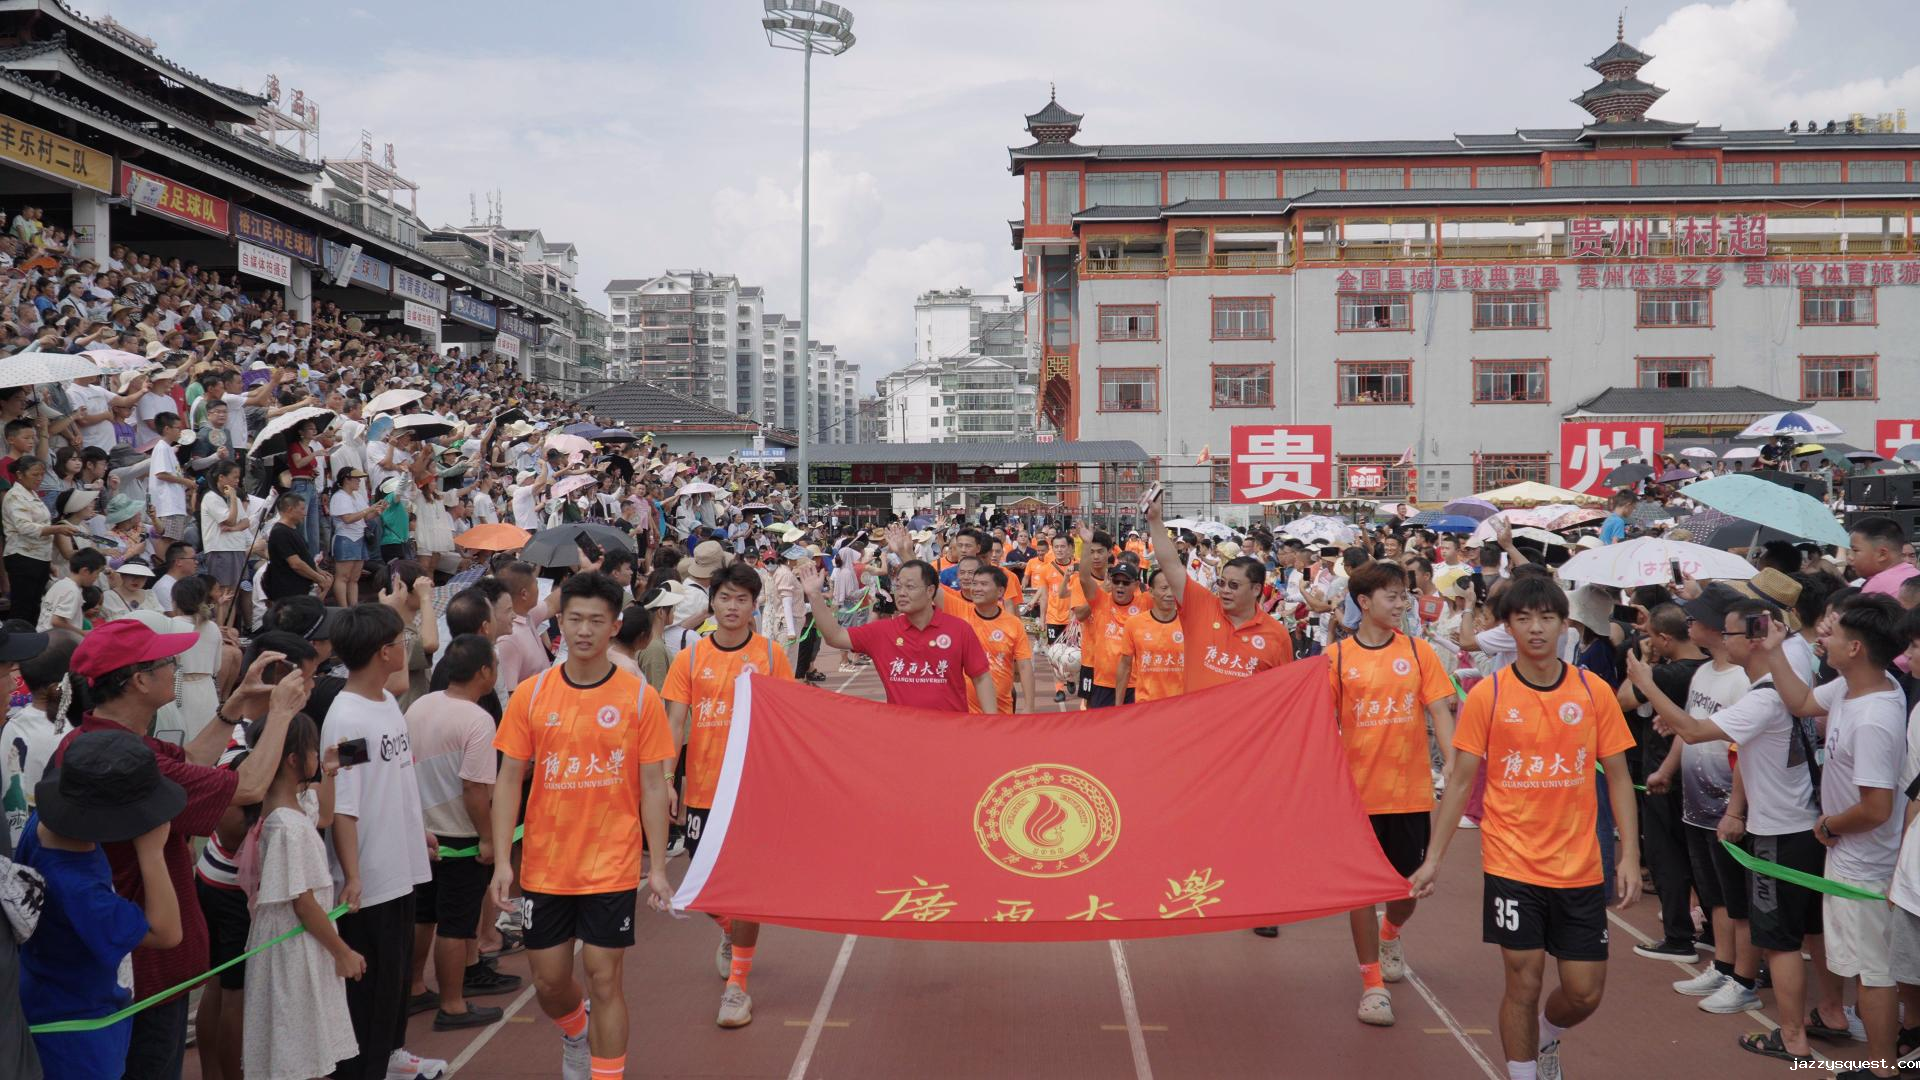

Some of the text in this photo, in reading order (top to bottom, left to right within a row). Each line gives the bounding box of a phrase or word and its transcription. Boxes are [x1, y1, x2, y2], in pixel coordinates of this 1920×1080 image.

[239, 211, 314, 257] 榕江民中足球队
[1568, 214, 1768, 257] 贵州 村超
[242, 253, 288, 279] 自媒体拍摄区
[1336, 266, 1561, 291] 全国县域足球典型县
[1578, 264, 1725, 287] 贵州体操之乡
[1238, 429, 1325, 499] 贵
[1350, 474, 1381, 488] 安全出口
[1494, 897, 1519, 932] 35
